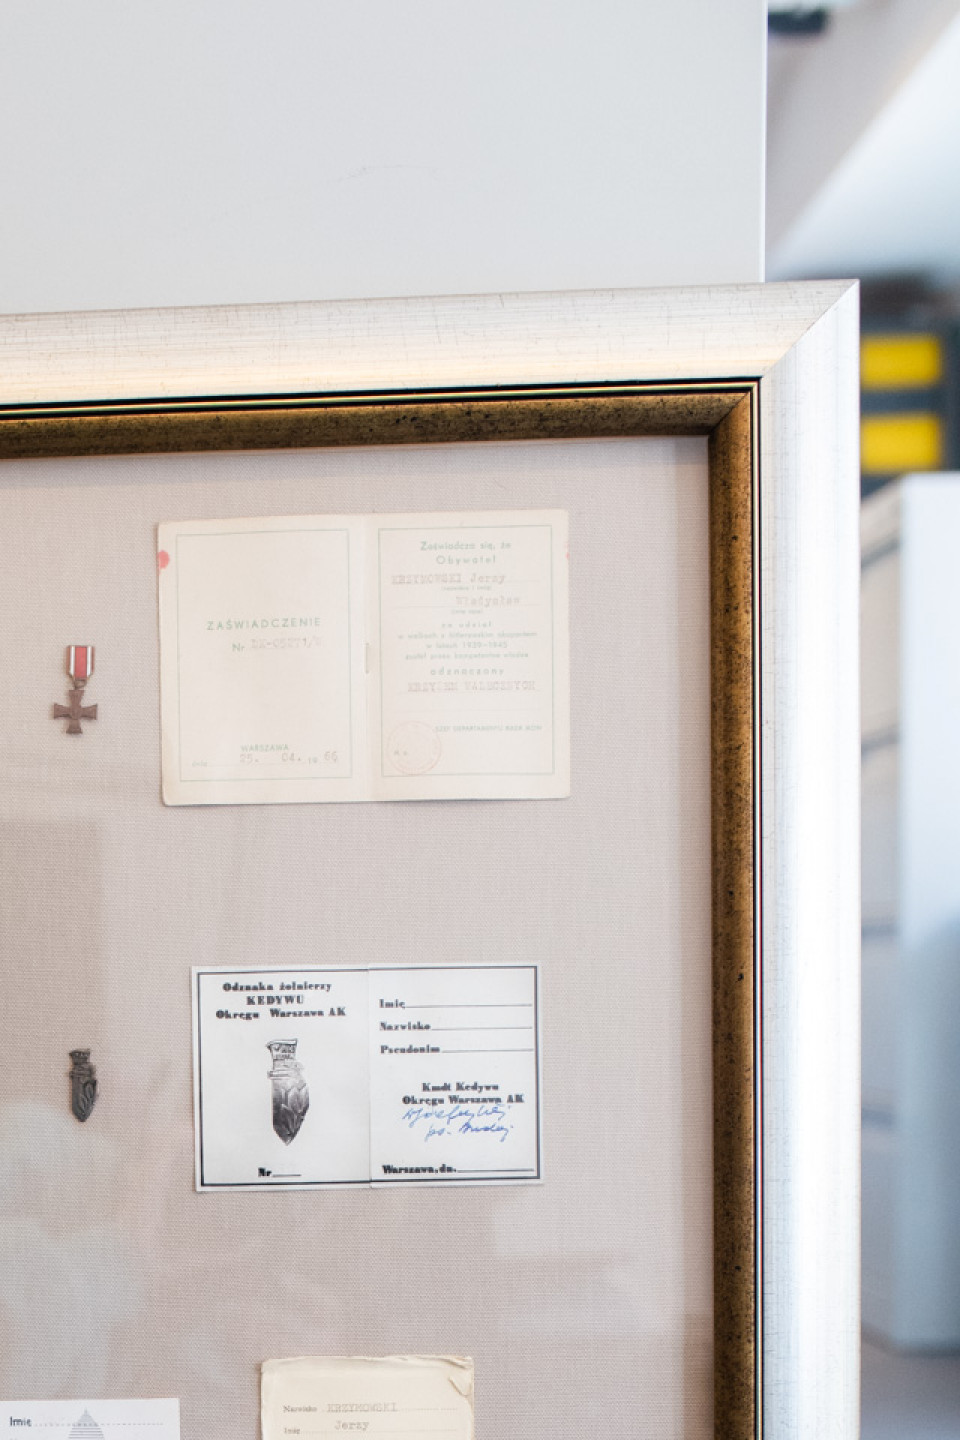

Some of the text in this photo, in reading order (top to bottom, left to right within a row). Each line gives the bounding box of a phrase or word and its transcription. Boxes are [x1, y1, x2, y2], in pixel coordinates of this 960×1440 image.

[436, 555, 496, 566] Obywatel
[206, 617, 321, 631] ZAŚWIADCZENIE
[232, 643, 245, 652] Nr
[222, 981, 274, 992] Odznaka
[246, 994, 304, 1006] KEDYWU
[215, 1009, 260, 1021] Okręgu
[328, 1006, 346, 1017] AK
[379, 1021, 431, 1031] Nazwisko
[380, 1044, 441, 1054] Pseudonim
[401, 1095, 445, 1106] Okręgu
[506, 1093, 525, 1104] AK
[257, 1166, 272, 1178] Nr
[10, 1416, 32, 1428] Imię
[334, 1420, 369, 1432] Jerzy
